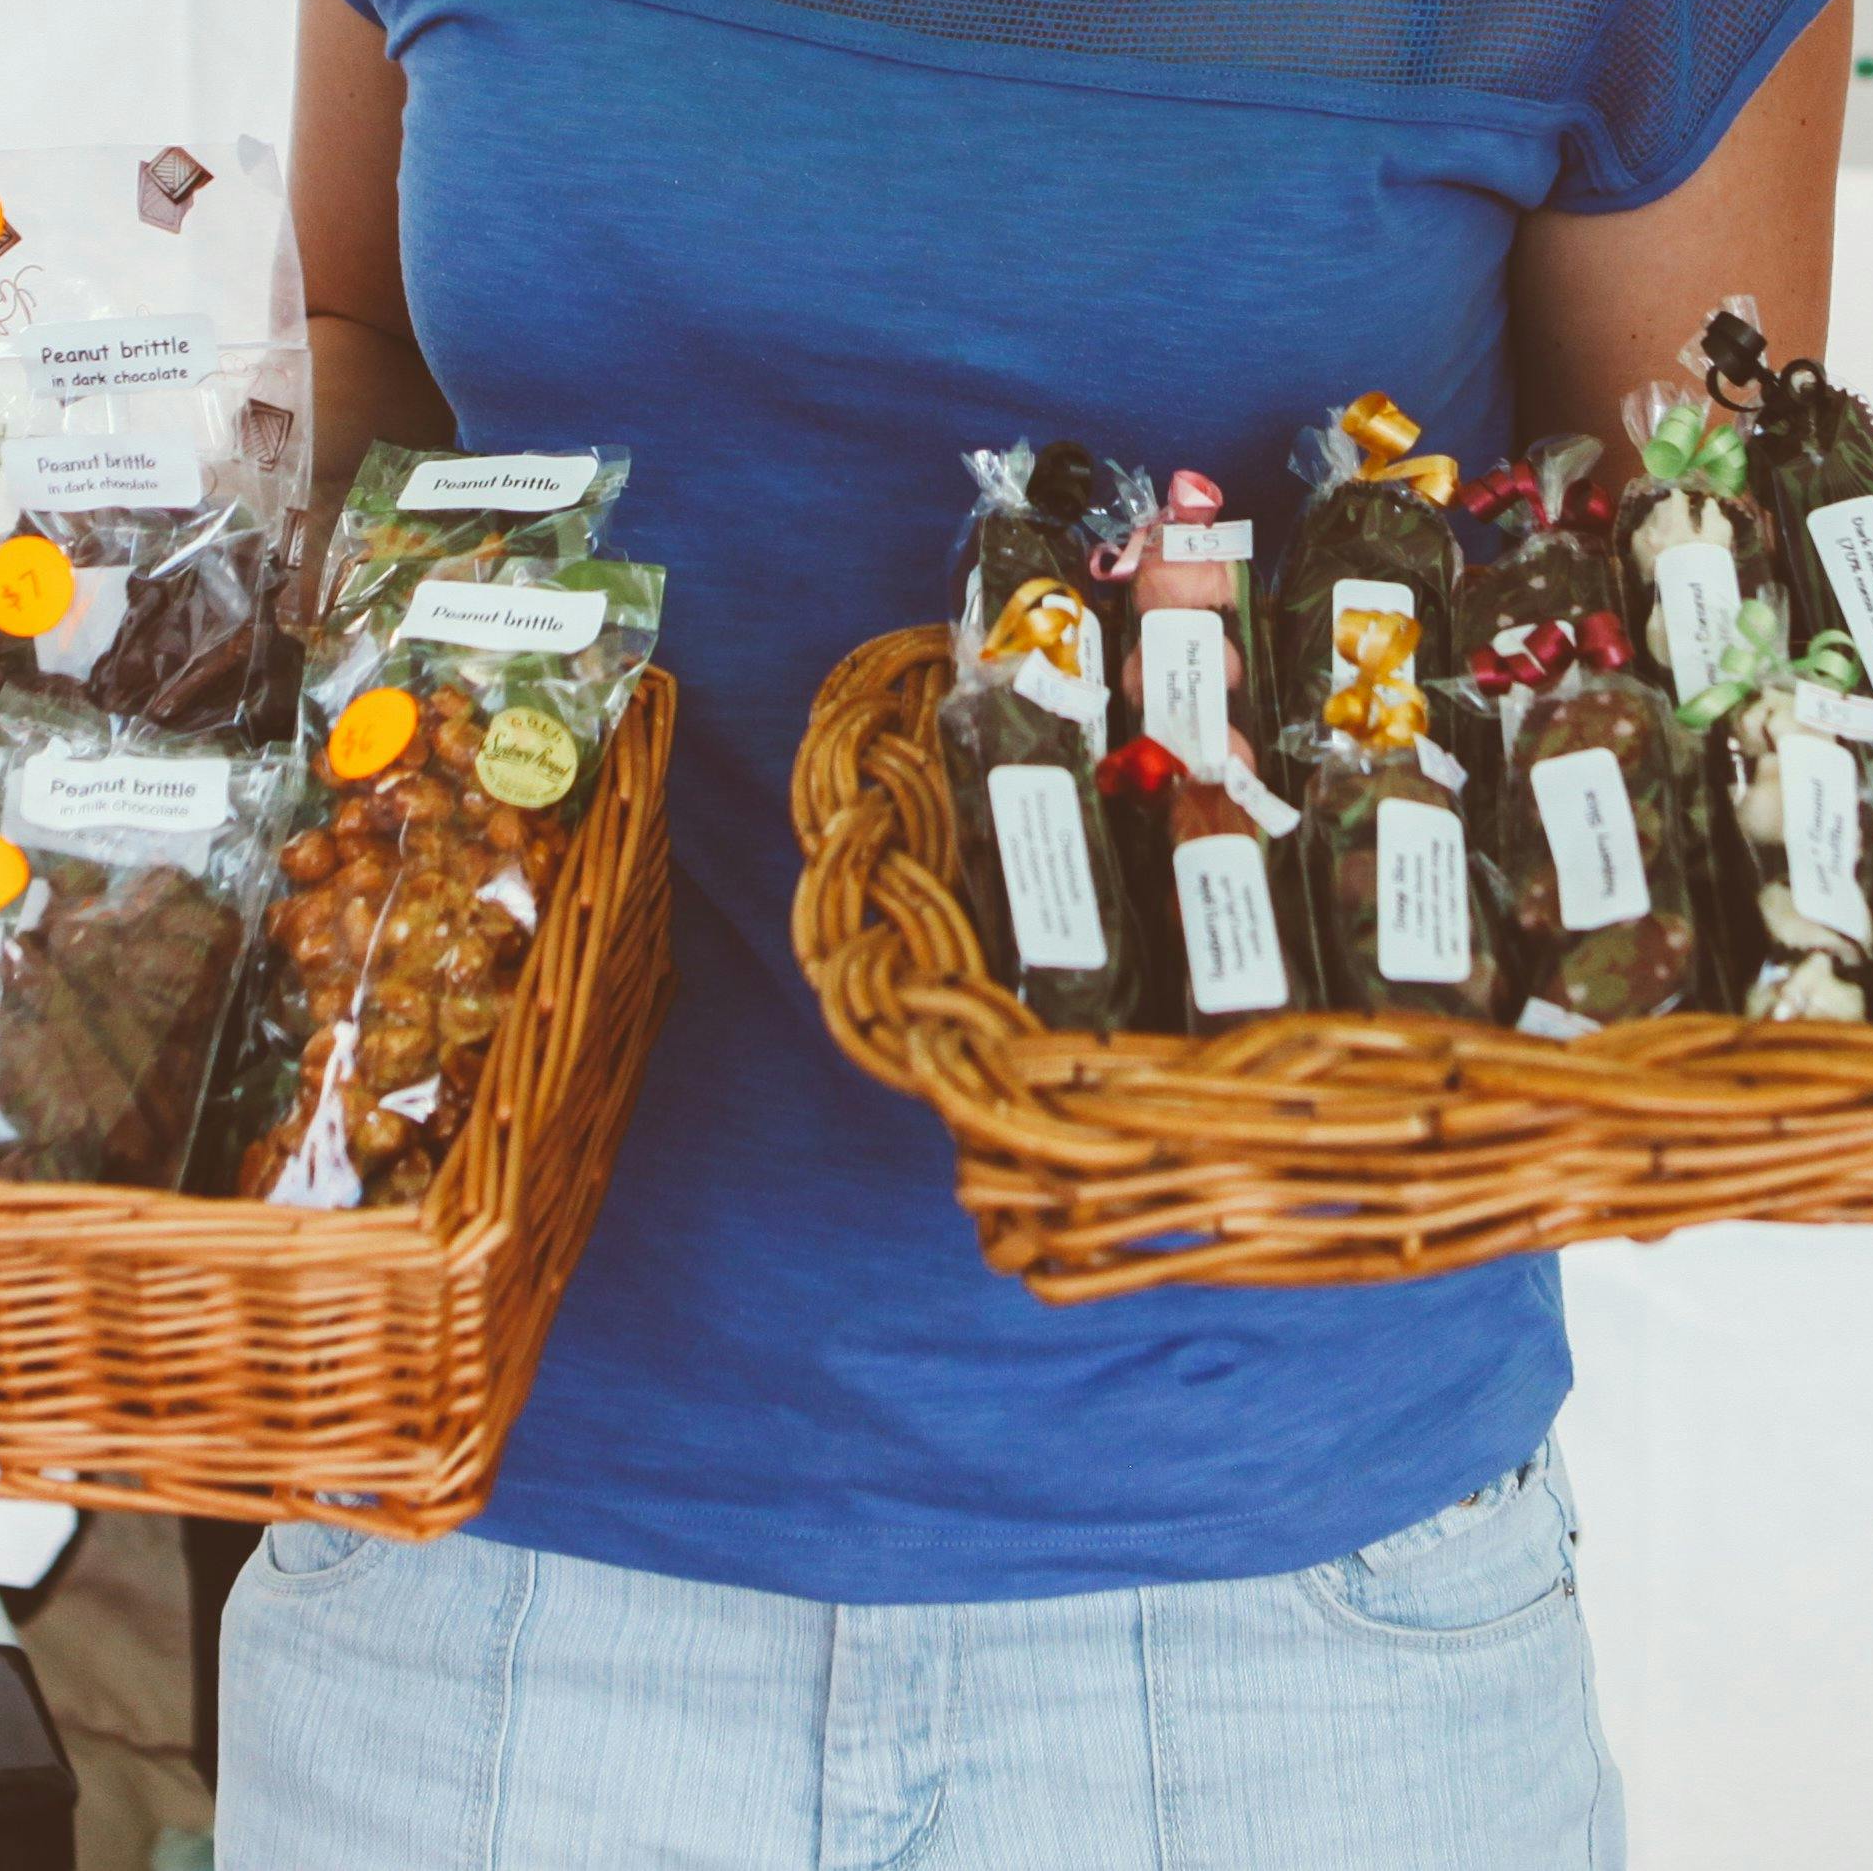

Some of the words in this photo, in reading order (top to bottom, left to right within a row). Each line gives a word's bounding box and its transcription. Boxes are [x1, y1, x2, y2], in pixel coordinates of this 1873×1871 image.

[41, 344, 109, 365] Peanut
[119, 336, 191, 360] brittle
[50, 372, 65, 389] in
[71, 373, 108, 387] dark
[113, 366, 189, 386] chocolate
[36, 456, 100, 475] Peanut
[103, 452, 157, 472] brittle
[46, 482, 61, 496] in
[63, 479, 95, 494] dark
[431, 475, 498, 491] Peanut
[501, 473, 561, 492] brittle
[431, 604, 500, 623] Peanut
[502, 608, 565, 633] brittle
[48, 778, 128, 799] Peanut
[131, 779, 199, 799] brittle
